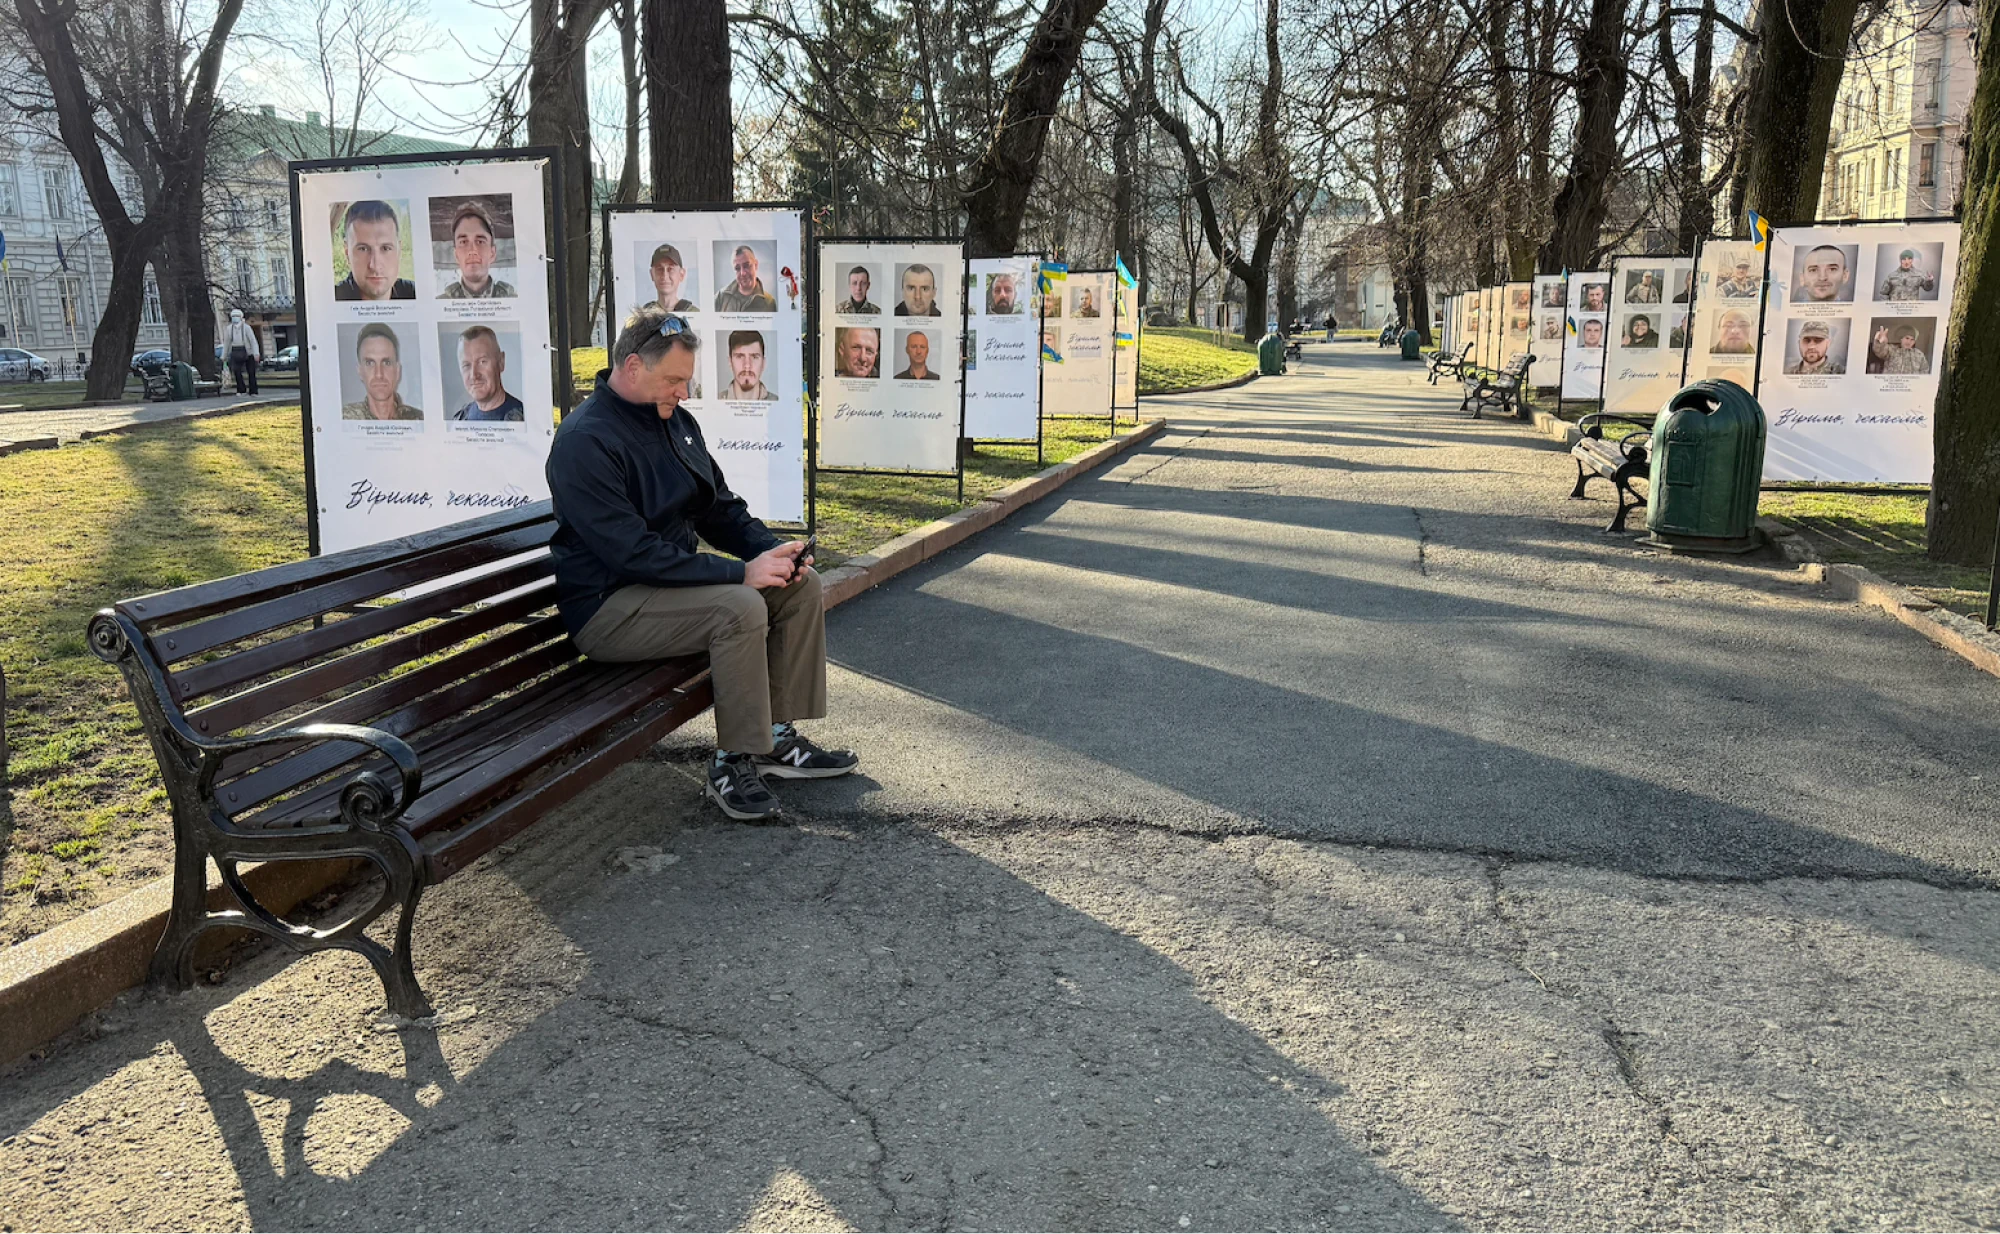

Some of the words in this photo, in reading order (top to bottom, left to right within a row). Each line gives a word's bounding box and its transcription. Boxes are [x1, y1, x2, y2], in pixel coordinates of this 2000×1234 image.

[1774, 407, 1845, 430] Віримо,
[717, 438, 785, 451] чекаємо
[345, 478, 434, 515] Віримо,
[445, 489, 534, 508] чекаємо
[781, 746, 812, 767] N
[714, 775, 734, 796] N
